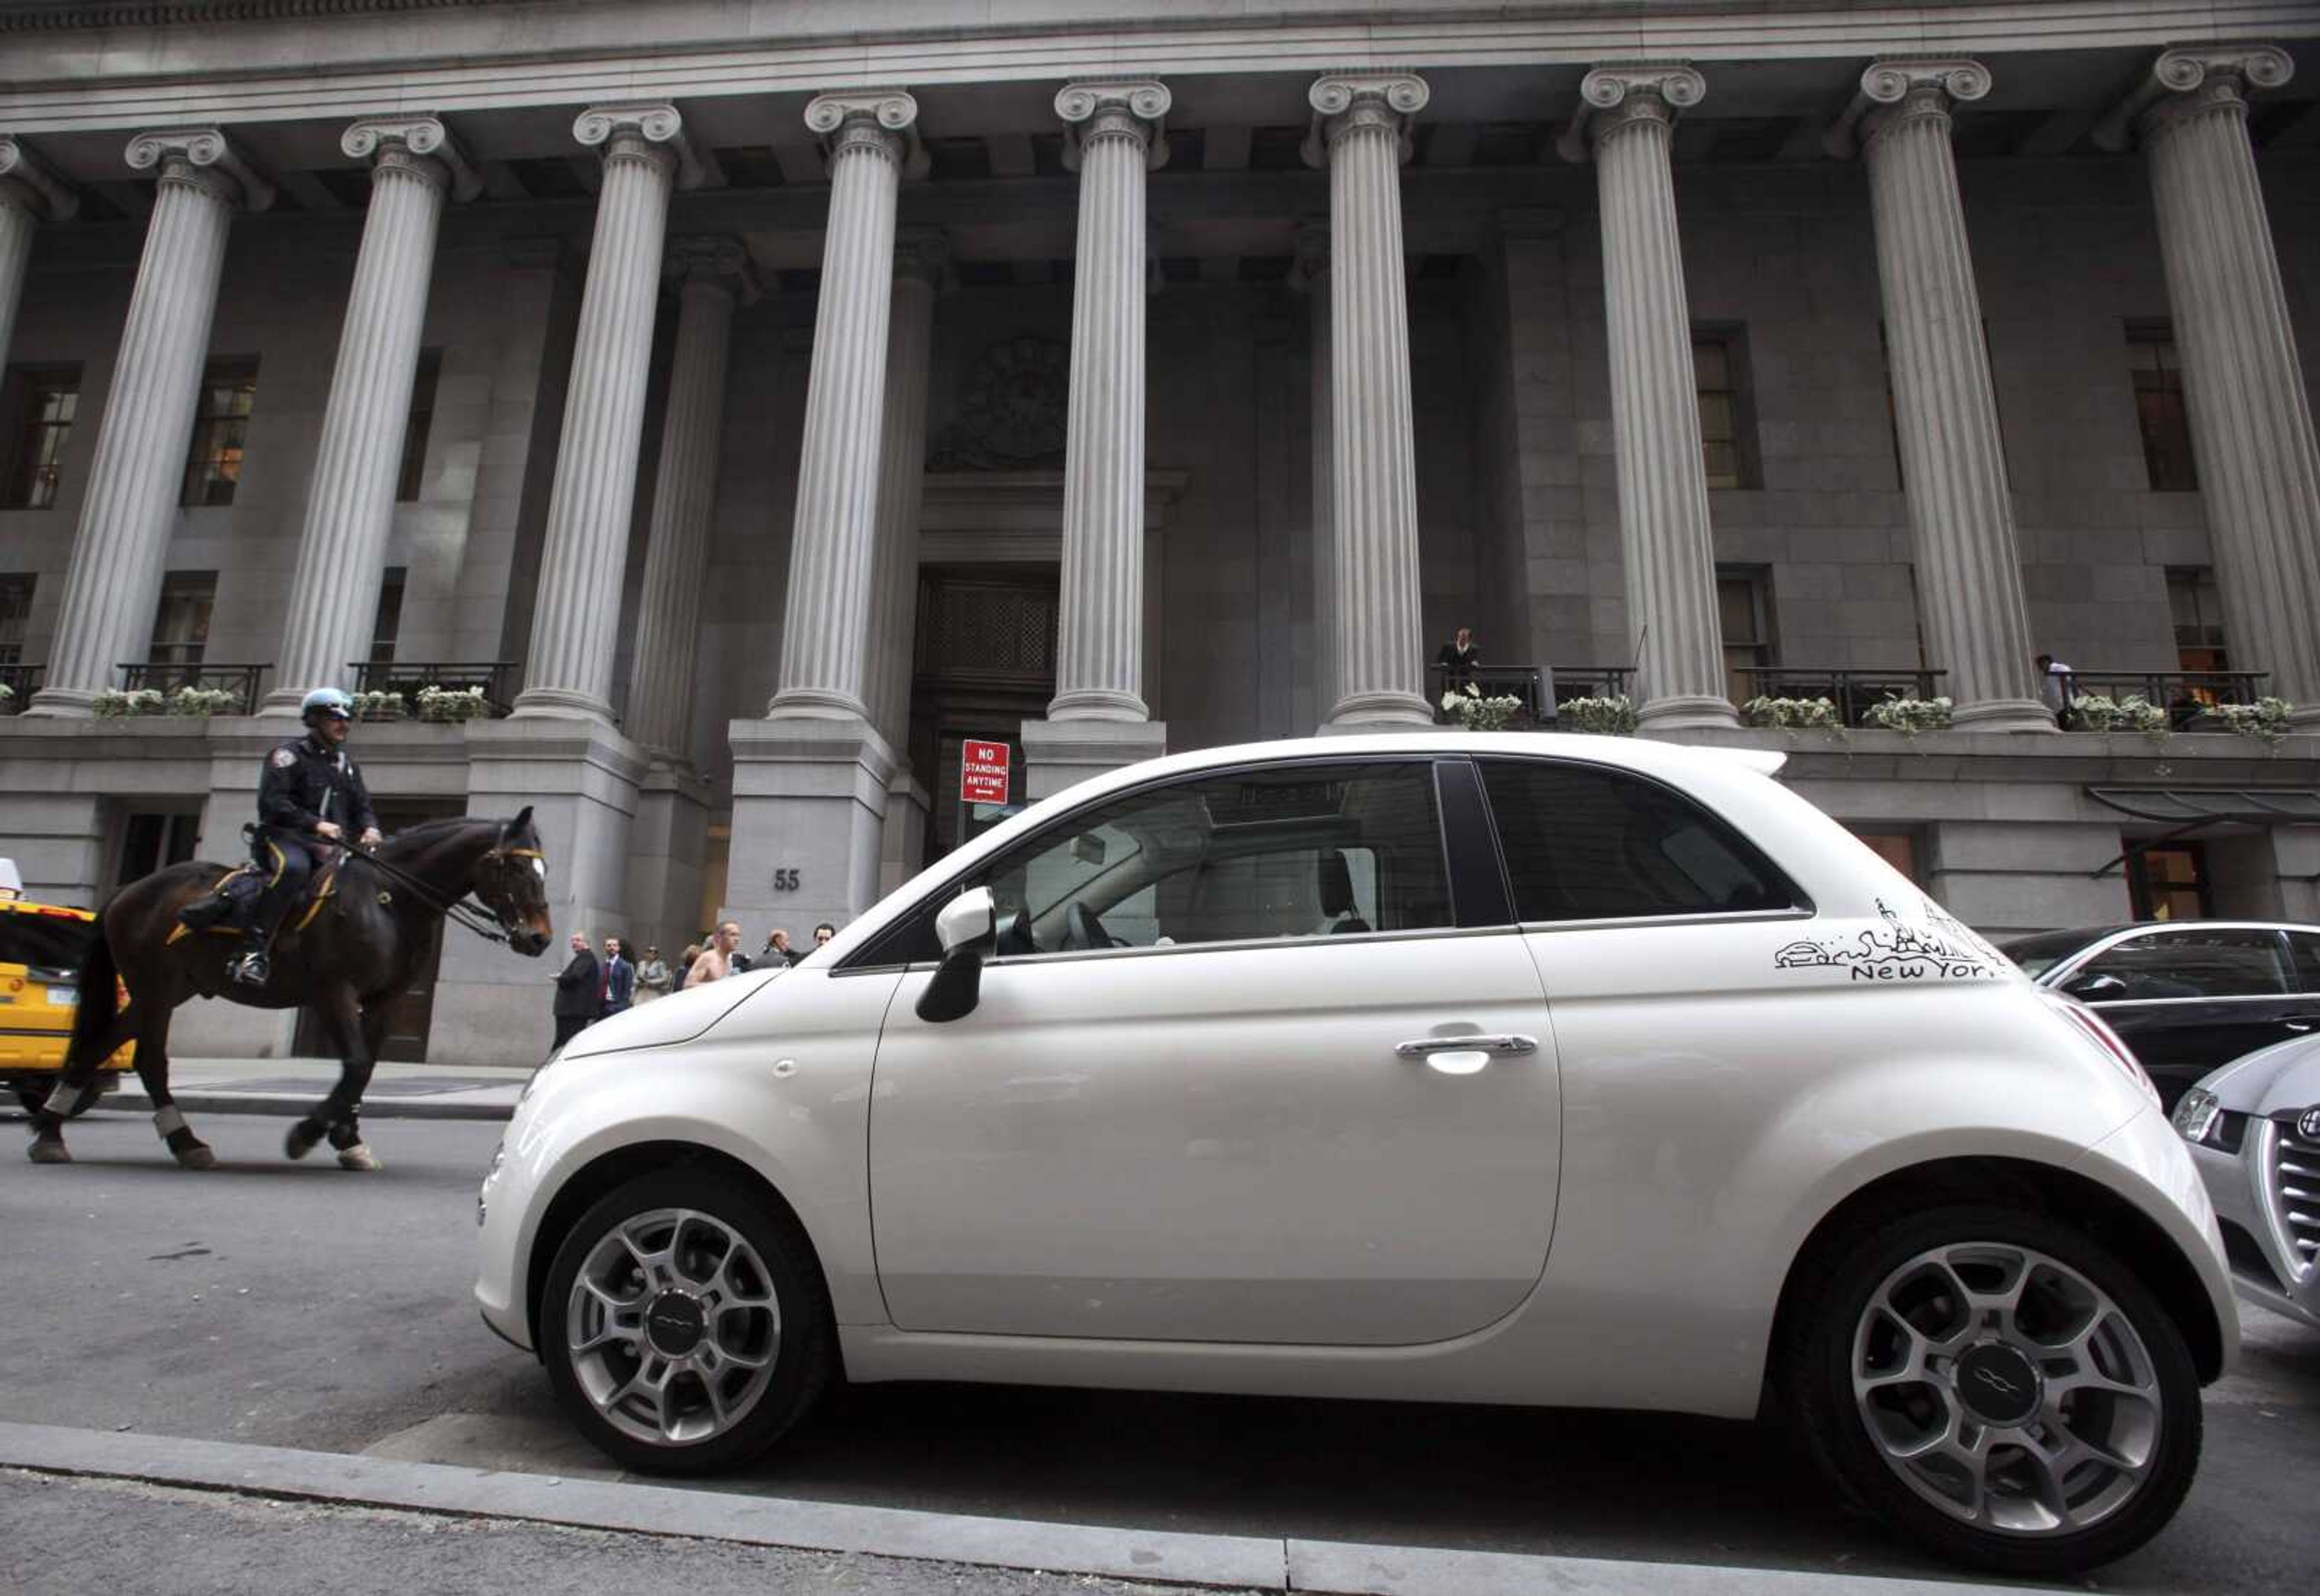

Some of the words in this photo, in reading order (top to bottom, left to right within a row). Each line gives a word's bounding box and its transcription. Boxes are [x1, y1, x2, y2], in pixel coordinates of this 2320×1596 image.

[979, 748, 994, 761] NO
[965, 762, 1006, 775] STANDING
[967, 776, 1004, 788] ANYTIME
[775, 869, 800, 892] 55
[1852, 964, 1924, 980] New
